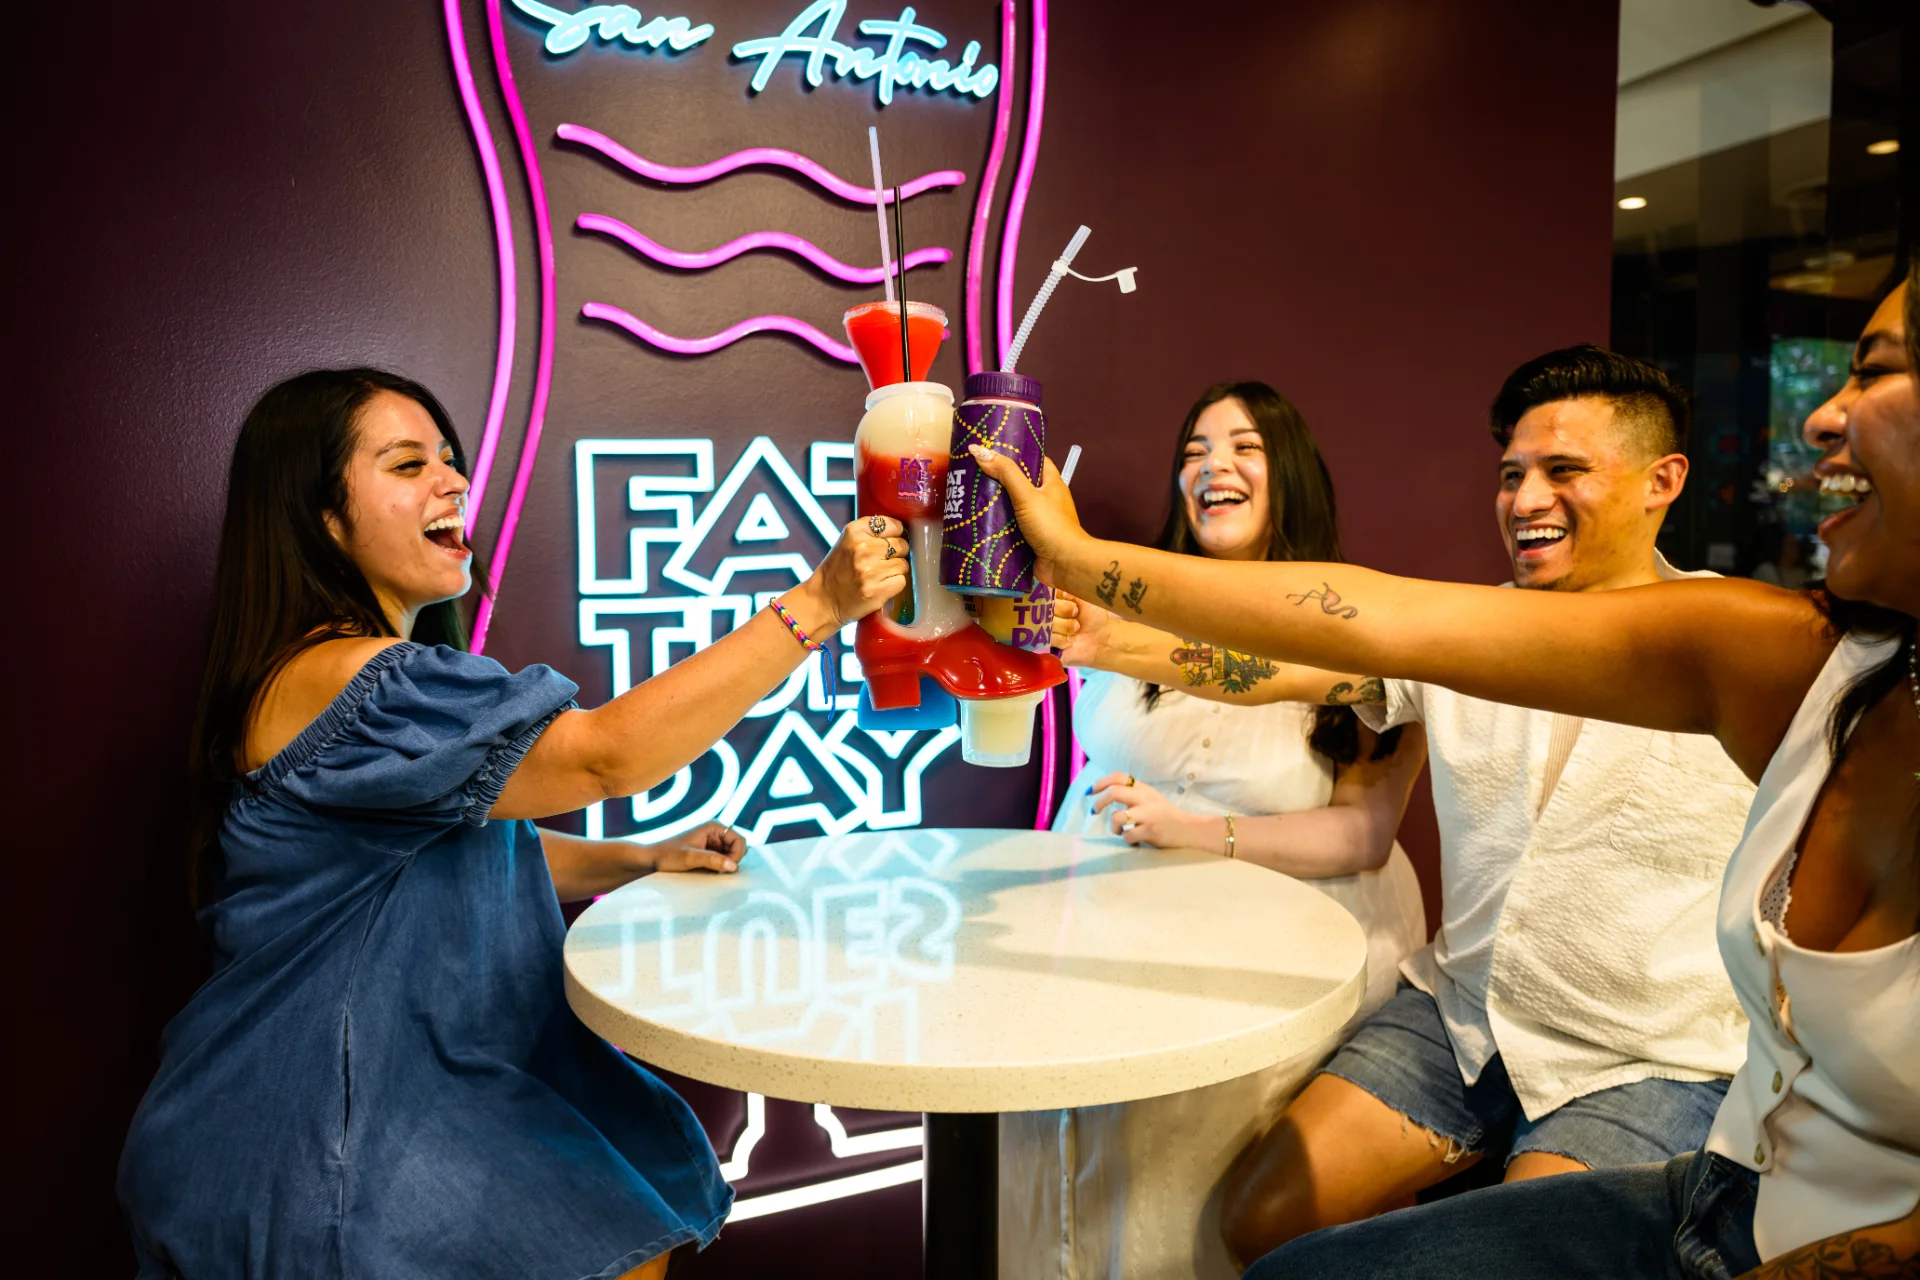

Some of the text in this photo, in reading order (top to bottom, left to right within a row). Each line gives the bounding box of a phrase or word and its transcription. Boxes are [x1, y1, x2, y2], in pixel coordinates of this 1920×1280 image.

[732, 0, 998, 104] Antonio
[900, 457, 932, 471] FAT
[946, 469, 966, 486] AT
[945, 485, 965, 500] UES
[944, 499, 964, 513] AY.
[1013, 604, 1055, 626] TUE
[586, 710, 961, 846] DAY
